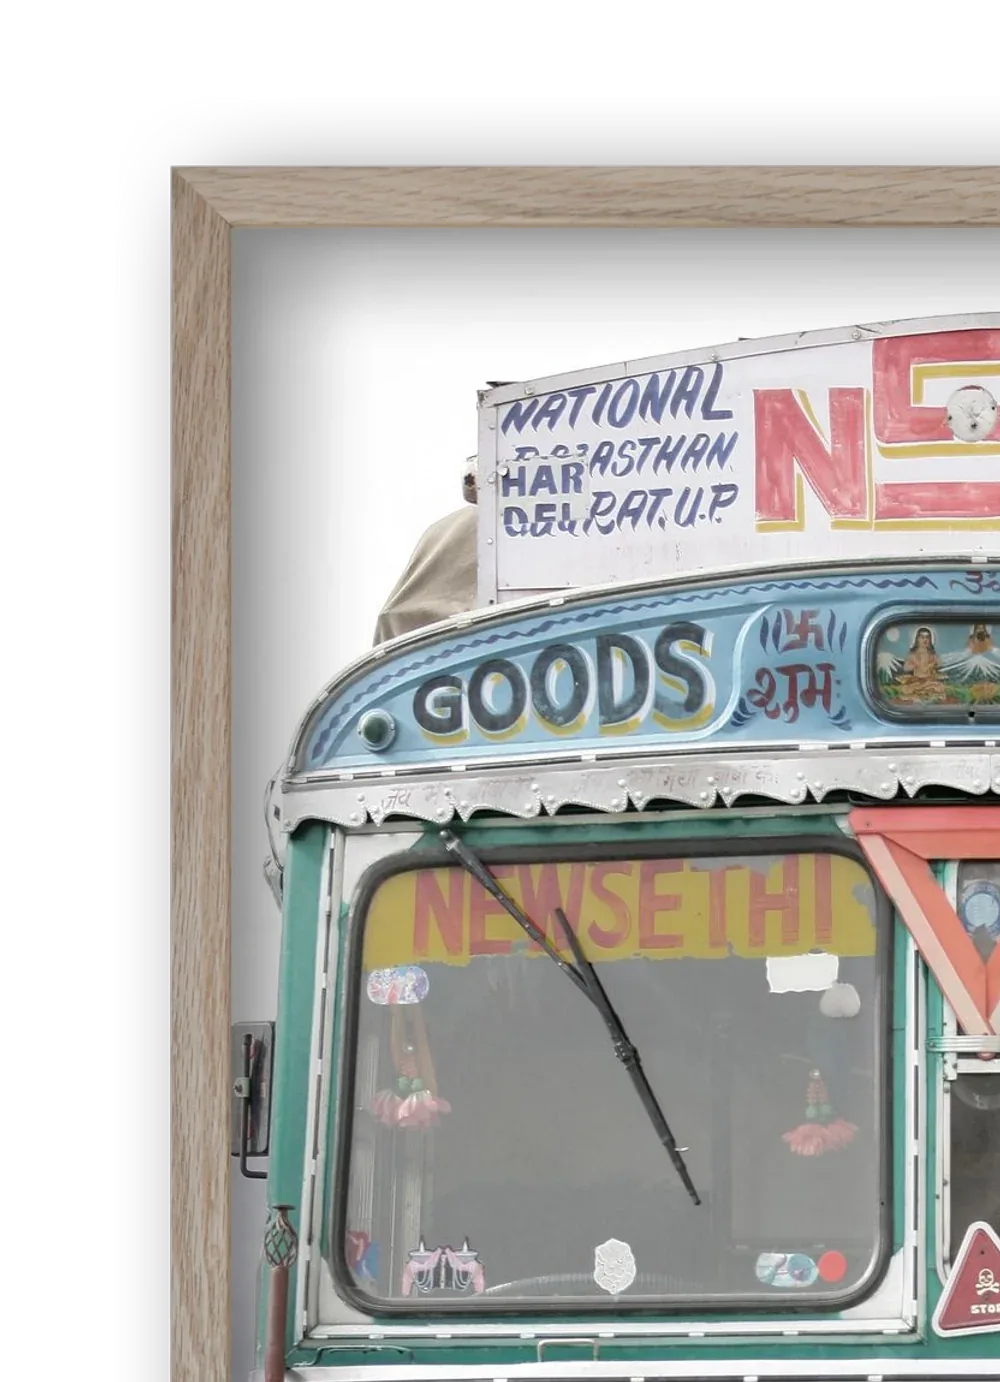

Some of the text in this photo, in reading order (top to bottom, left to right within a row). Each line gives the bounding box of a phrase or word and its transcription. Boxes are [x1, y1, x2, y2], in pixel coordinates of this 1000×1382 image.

[501, 362, 733, 434] NATIONAL
[502, 462, 584, 497] HAR
[413, 620, 715, 745] GOODS
